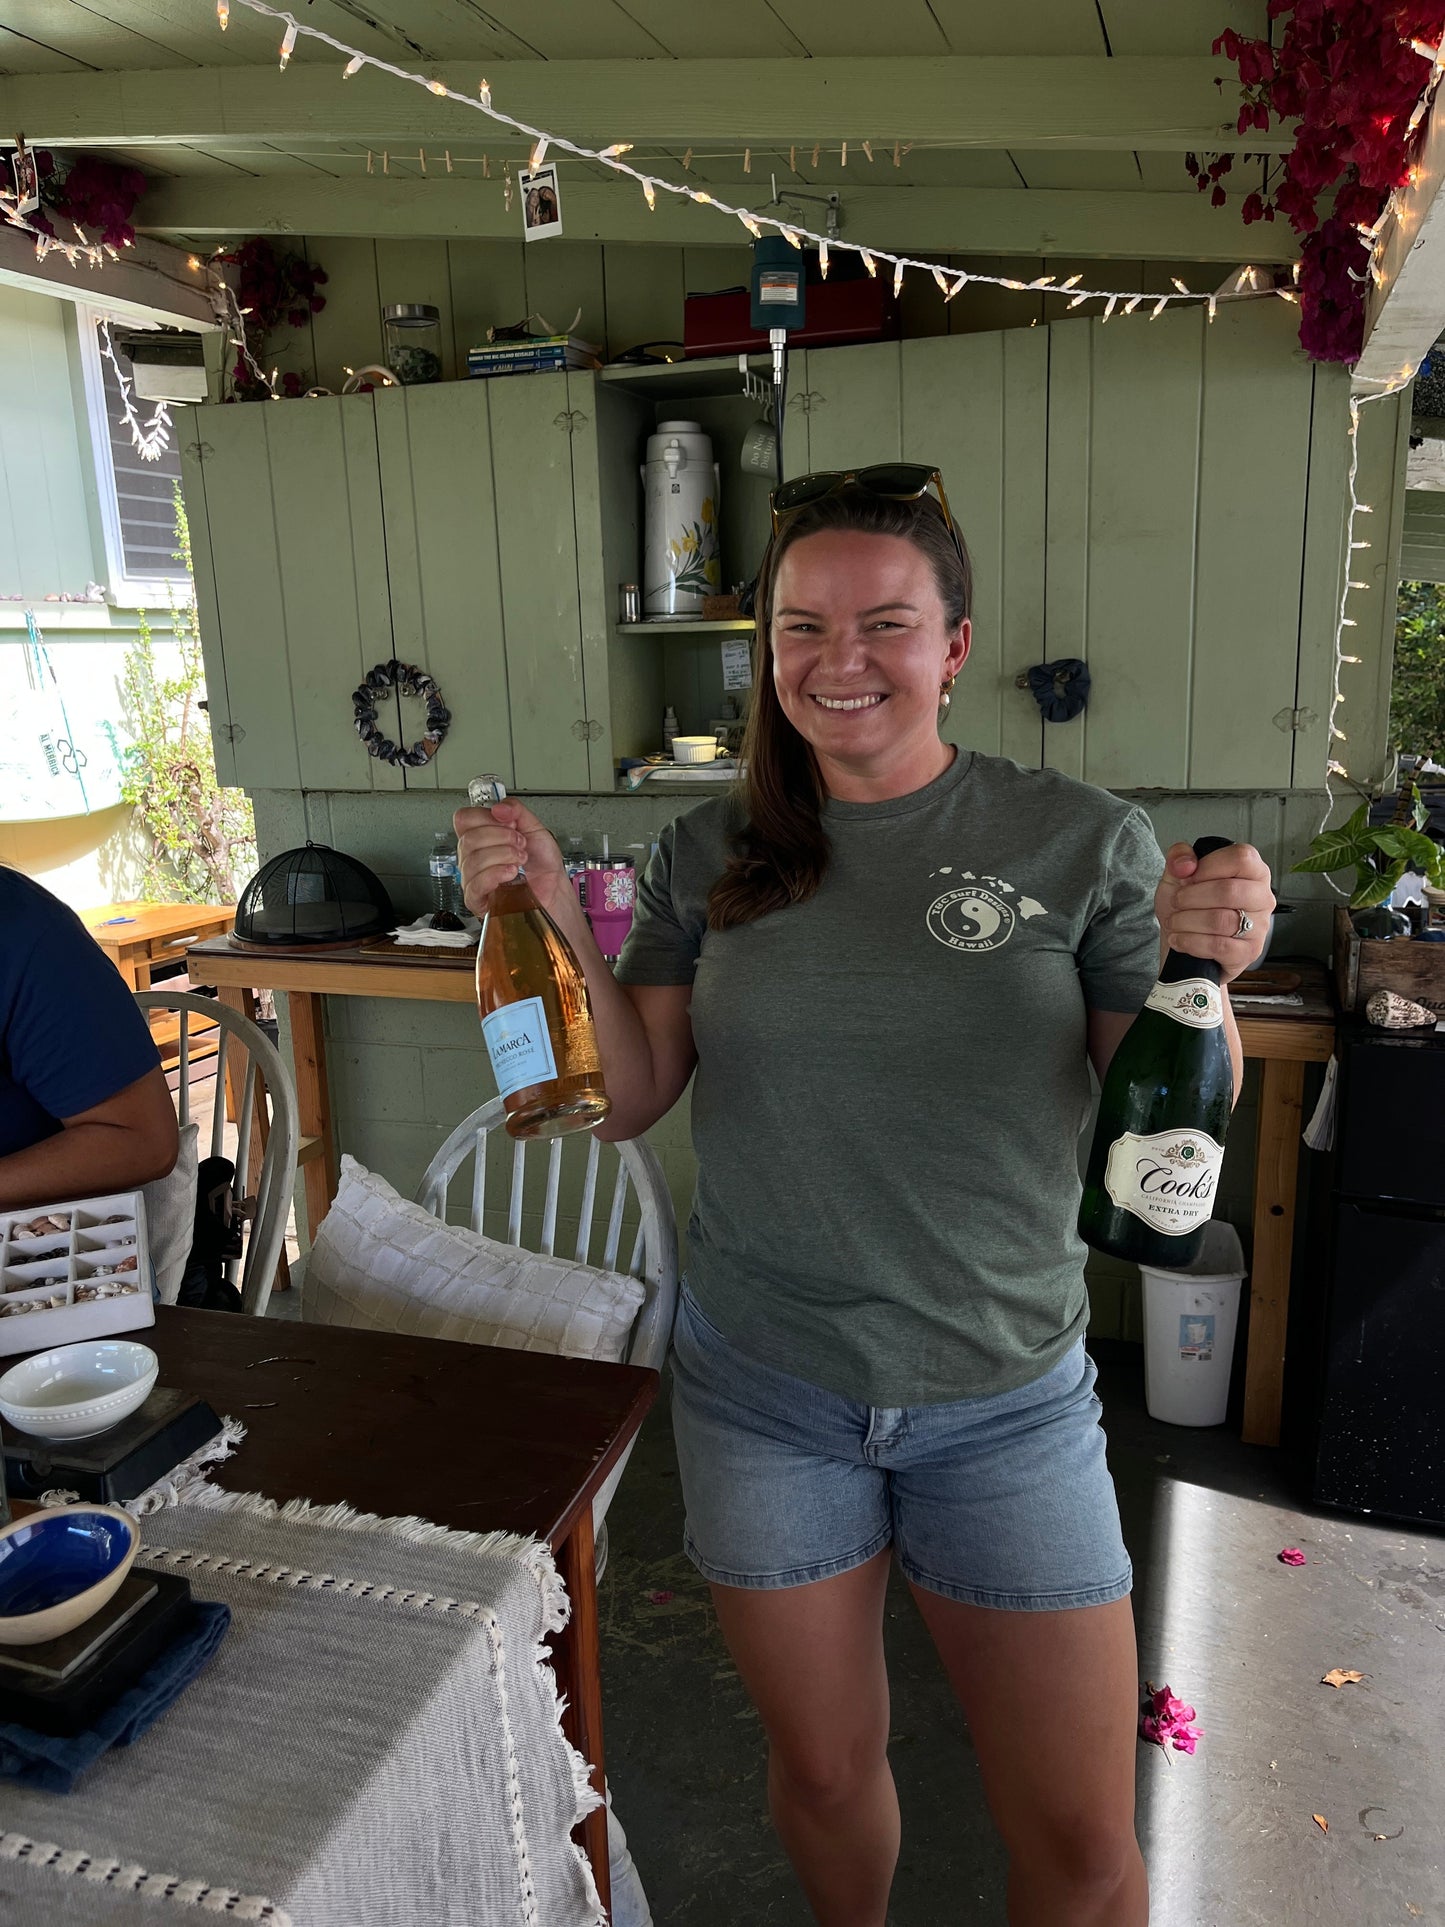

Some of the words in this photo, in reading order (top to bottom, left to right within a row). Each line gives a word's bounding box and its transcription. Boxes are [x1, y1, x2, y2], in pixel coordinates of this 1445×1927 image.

[515, 351, 535, 359] REVEALED
[753, 434, 767, 451] Not
[751, 452, 760, 466] Do
[760, 435, 776, 469] Disturb
[40, 734, 50, 743] AL
[44, 744, 60, 777] MERRICK
[949, 890, 977, 900] Surf
[979, 891, 1010, 917] Designs
[948, 937, 994, 949] Hawaii
[1136, 1158, 1214, 1199] Cook's
[1141, 1194, 1177, 1206] CALIFORNIA
[1148, 1204, 1180, 1215] EXTRA
